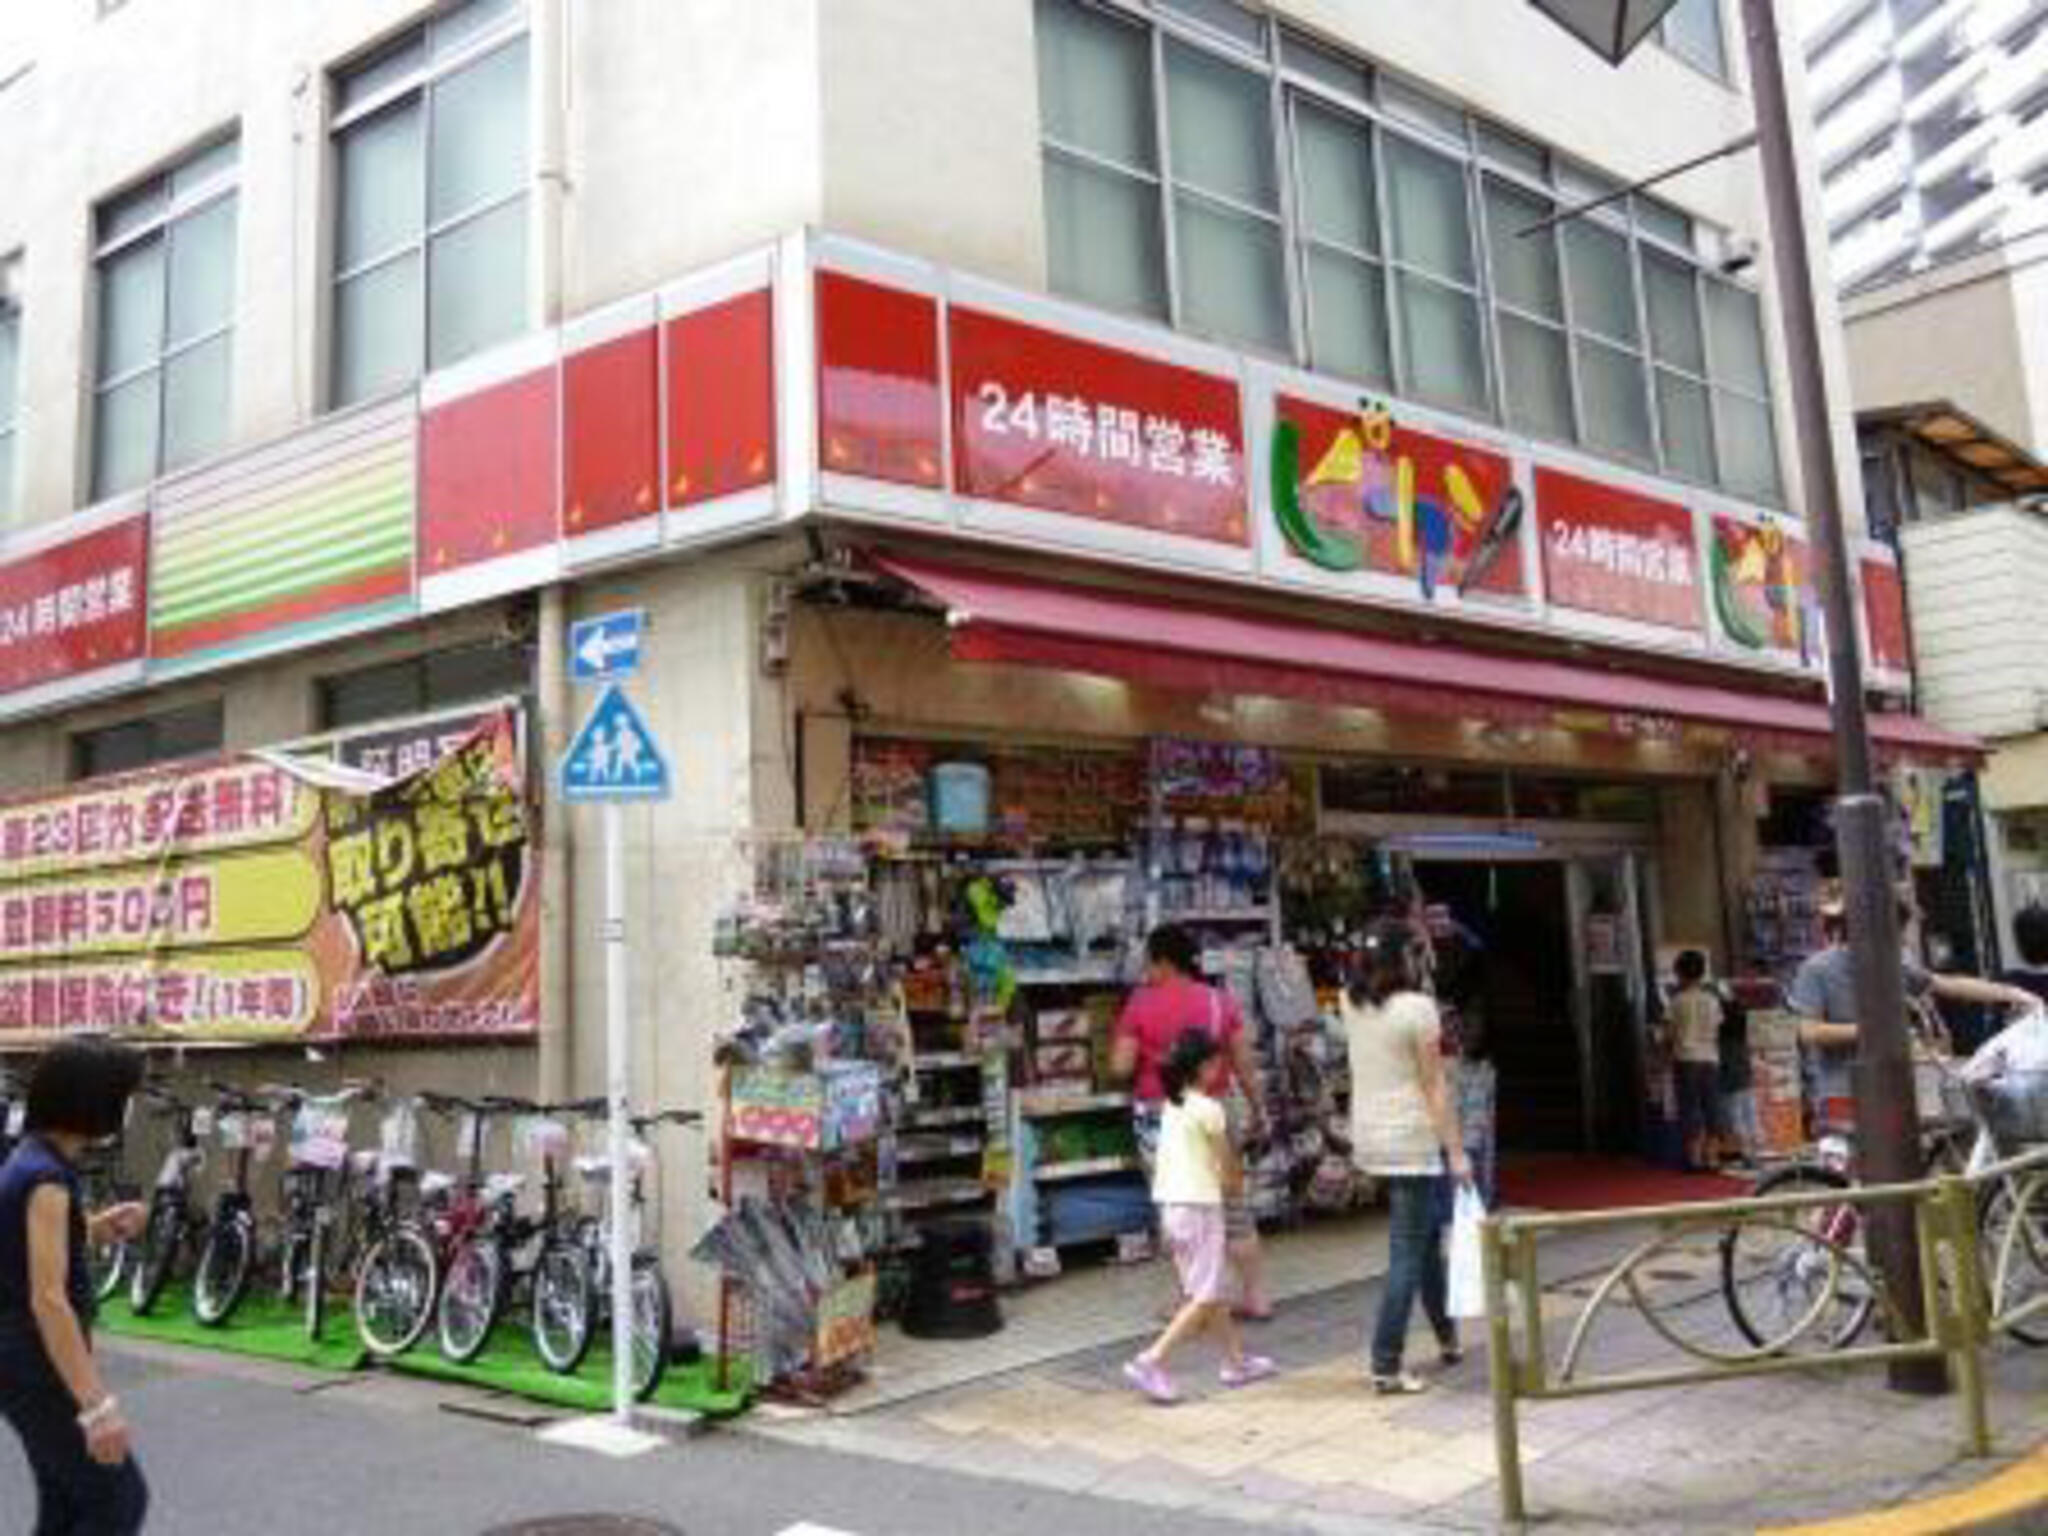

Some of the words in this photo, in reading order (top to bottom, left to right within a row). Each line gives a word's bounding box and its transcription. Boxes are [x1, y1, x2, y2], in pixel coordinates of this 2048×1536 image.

[980, 382, 1236, 486] 24時間営業
[1553, 519, 1693, 585] 24時間営業
